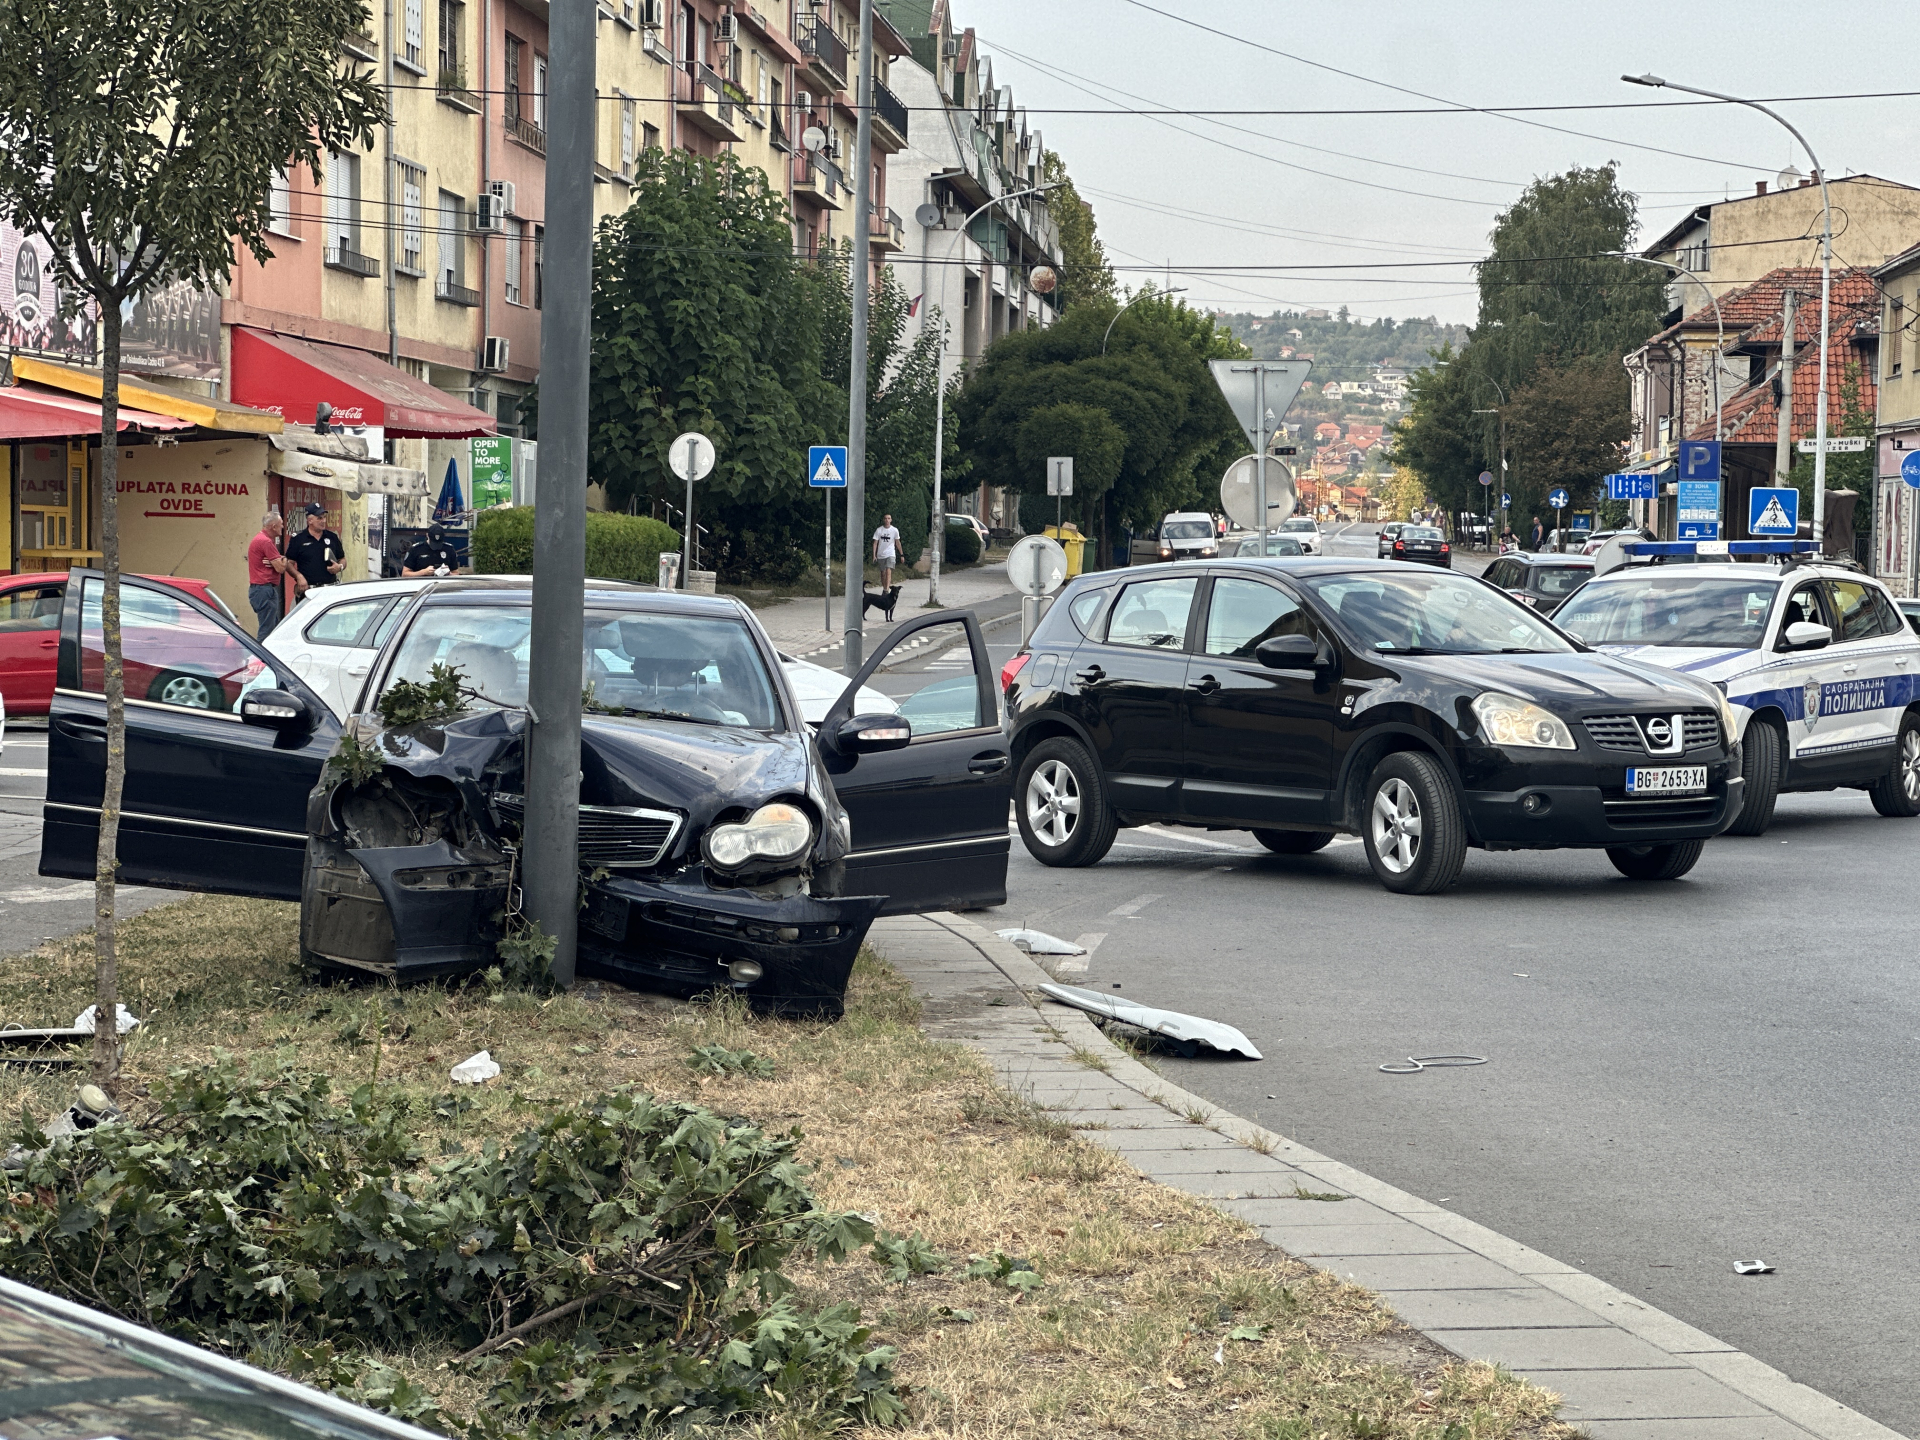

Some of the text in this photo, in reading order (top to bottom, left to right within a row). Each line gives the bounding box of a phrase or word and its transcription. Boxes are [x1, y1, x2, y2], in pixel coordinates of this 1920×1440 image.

[20, 250, 34, 278] 30
[474, 440, 498, 448] OPEN
[475, 457, 500, 465] MORE
[1688, 446, 1710, 475] P
[116, 480, 249, 495] UPLATA RAČUNA
[160, 498, 203, 511] OVDE
[1825, 679, 1885, 695] САОБРАЋАЈНА
[1824, 690, 1885, 714] ПОЛИЦИЈА
[1637, 771, 1651, 788] BG
